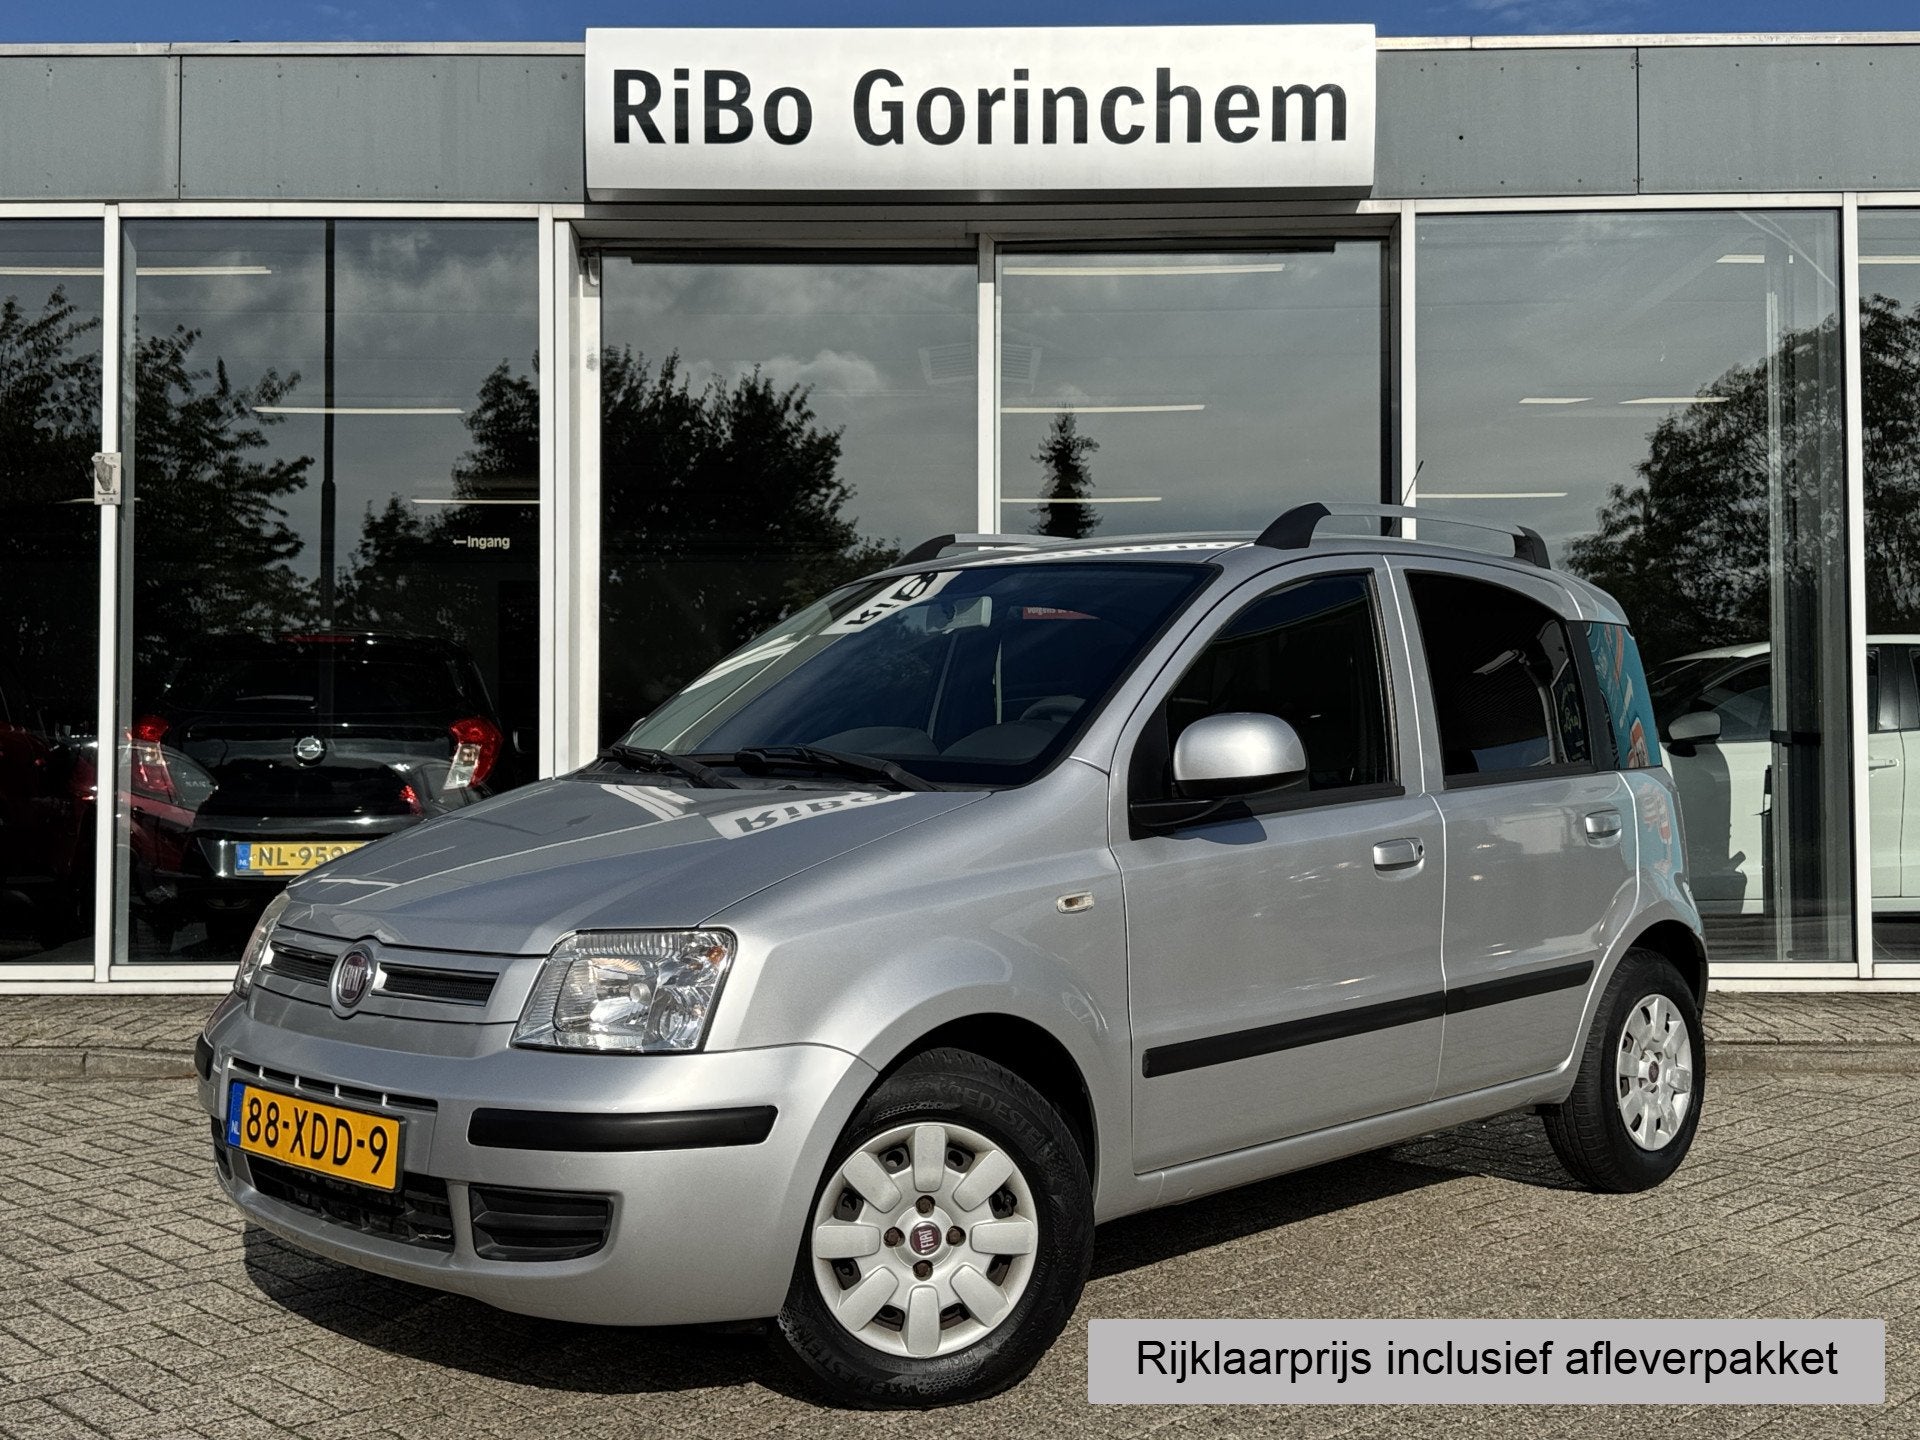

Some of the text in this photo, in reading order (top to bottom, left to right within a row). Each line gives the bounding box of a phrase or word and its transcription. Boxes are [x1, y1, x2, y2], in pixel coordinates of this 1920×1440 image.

[613, 67, 1347, 147] RiBo Gorinchem
[467, 535, 510, 550] Ingang
[247, 1097, 388, 1174] 88-XDD-9
[918, 1229, 935, 1249] FIAT
